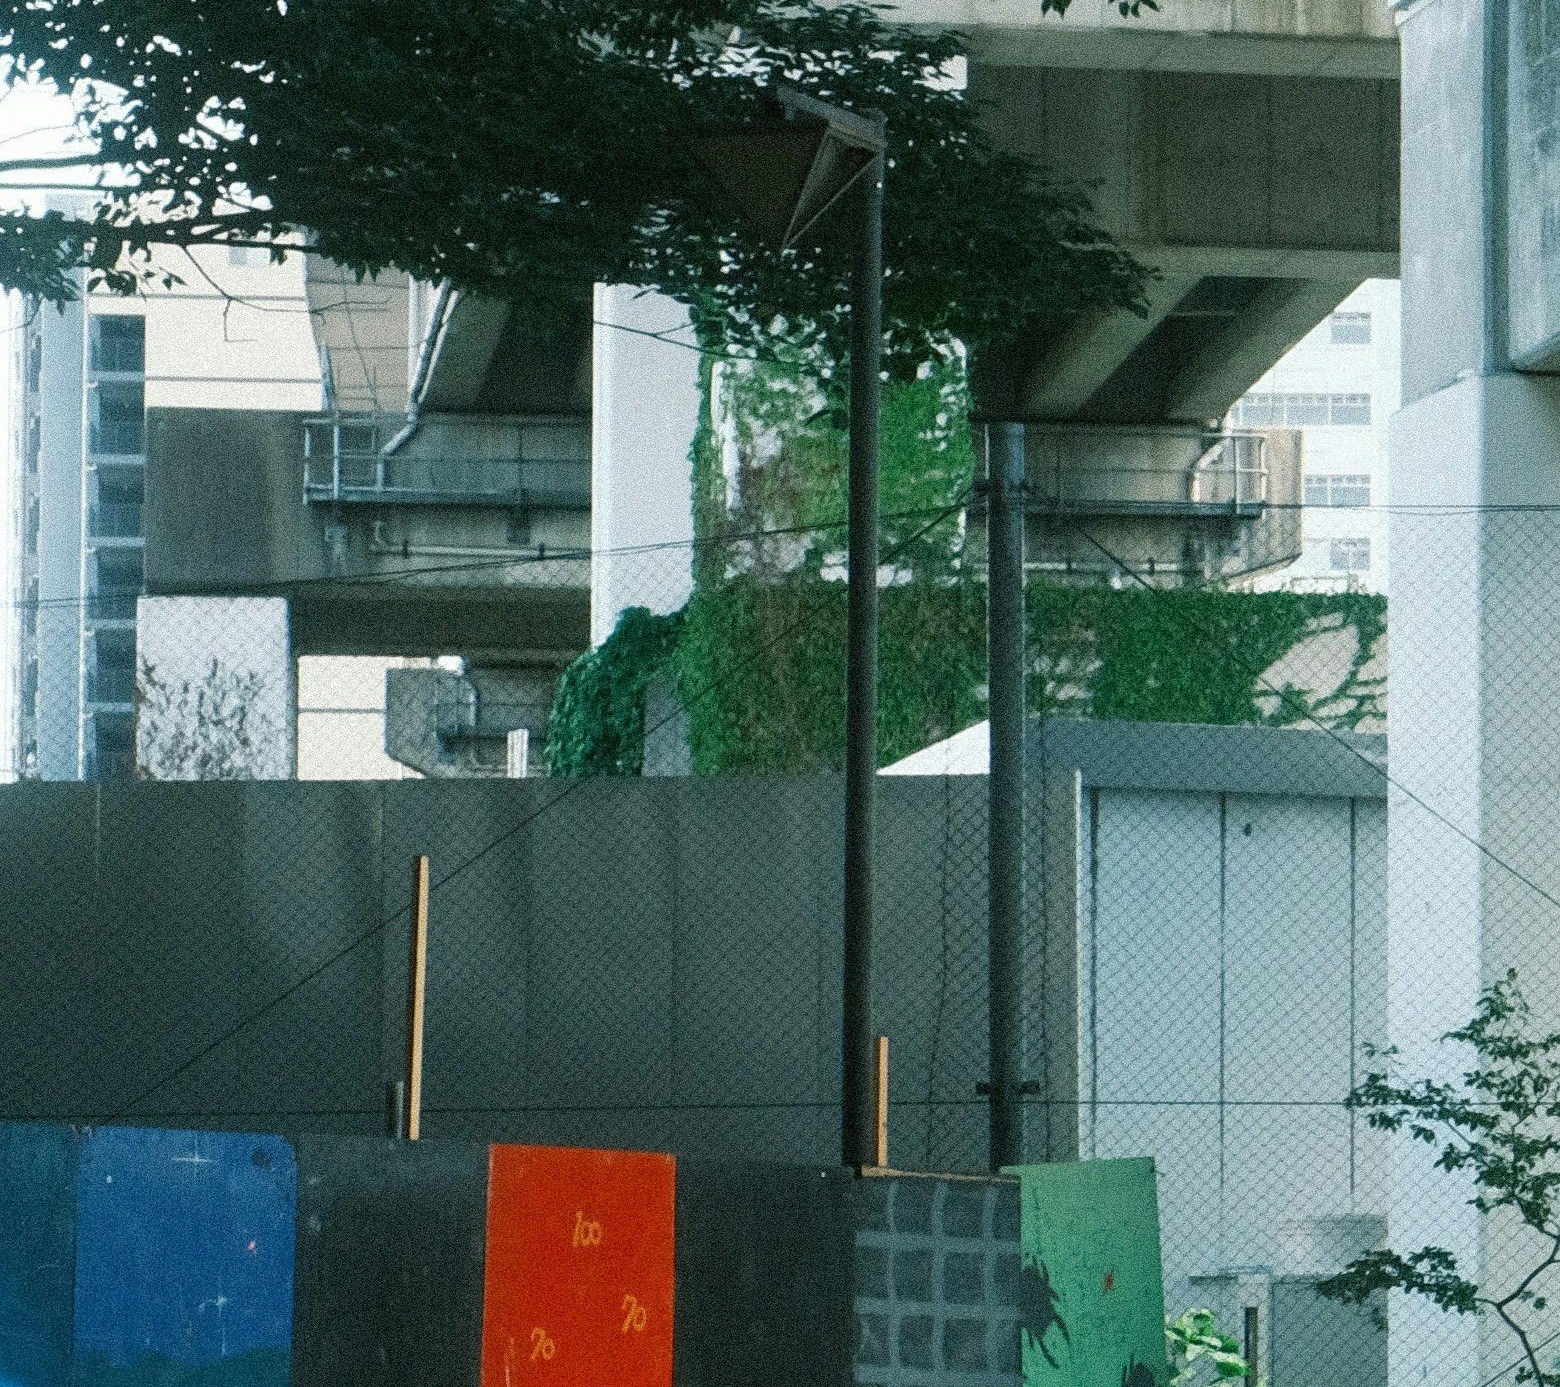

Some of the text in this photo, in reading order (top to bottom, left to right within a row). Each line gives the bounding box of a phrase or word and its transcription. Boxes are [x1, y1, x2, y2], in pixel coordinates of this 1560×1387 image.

[573, 1211, 601, 1247] 100
[621, 1294, 646, 1332] 70
[531, 1327, 555, 1360] 70
